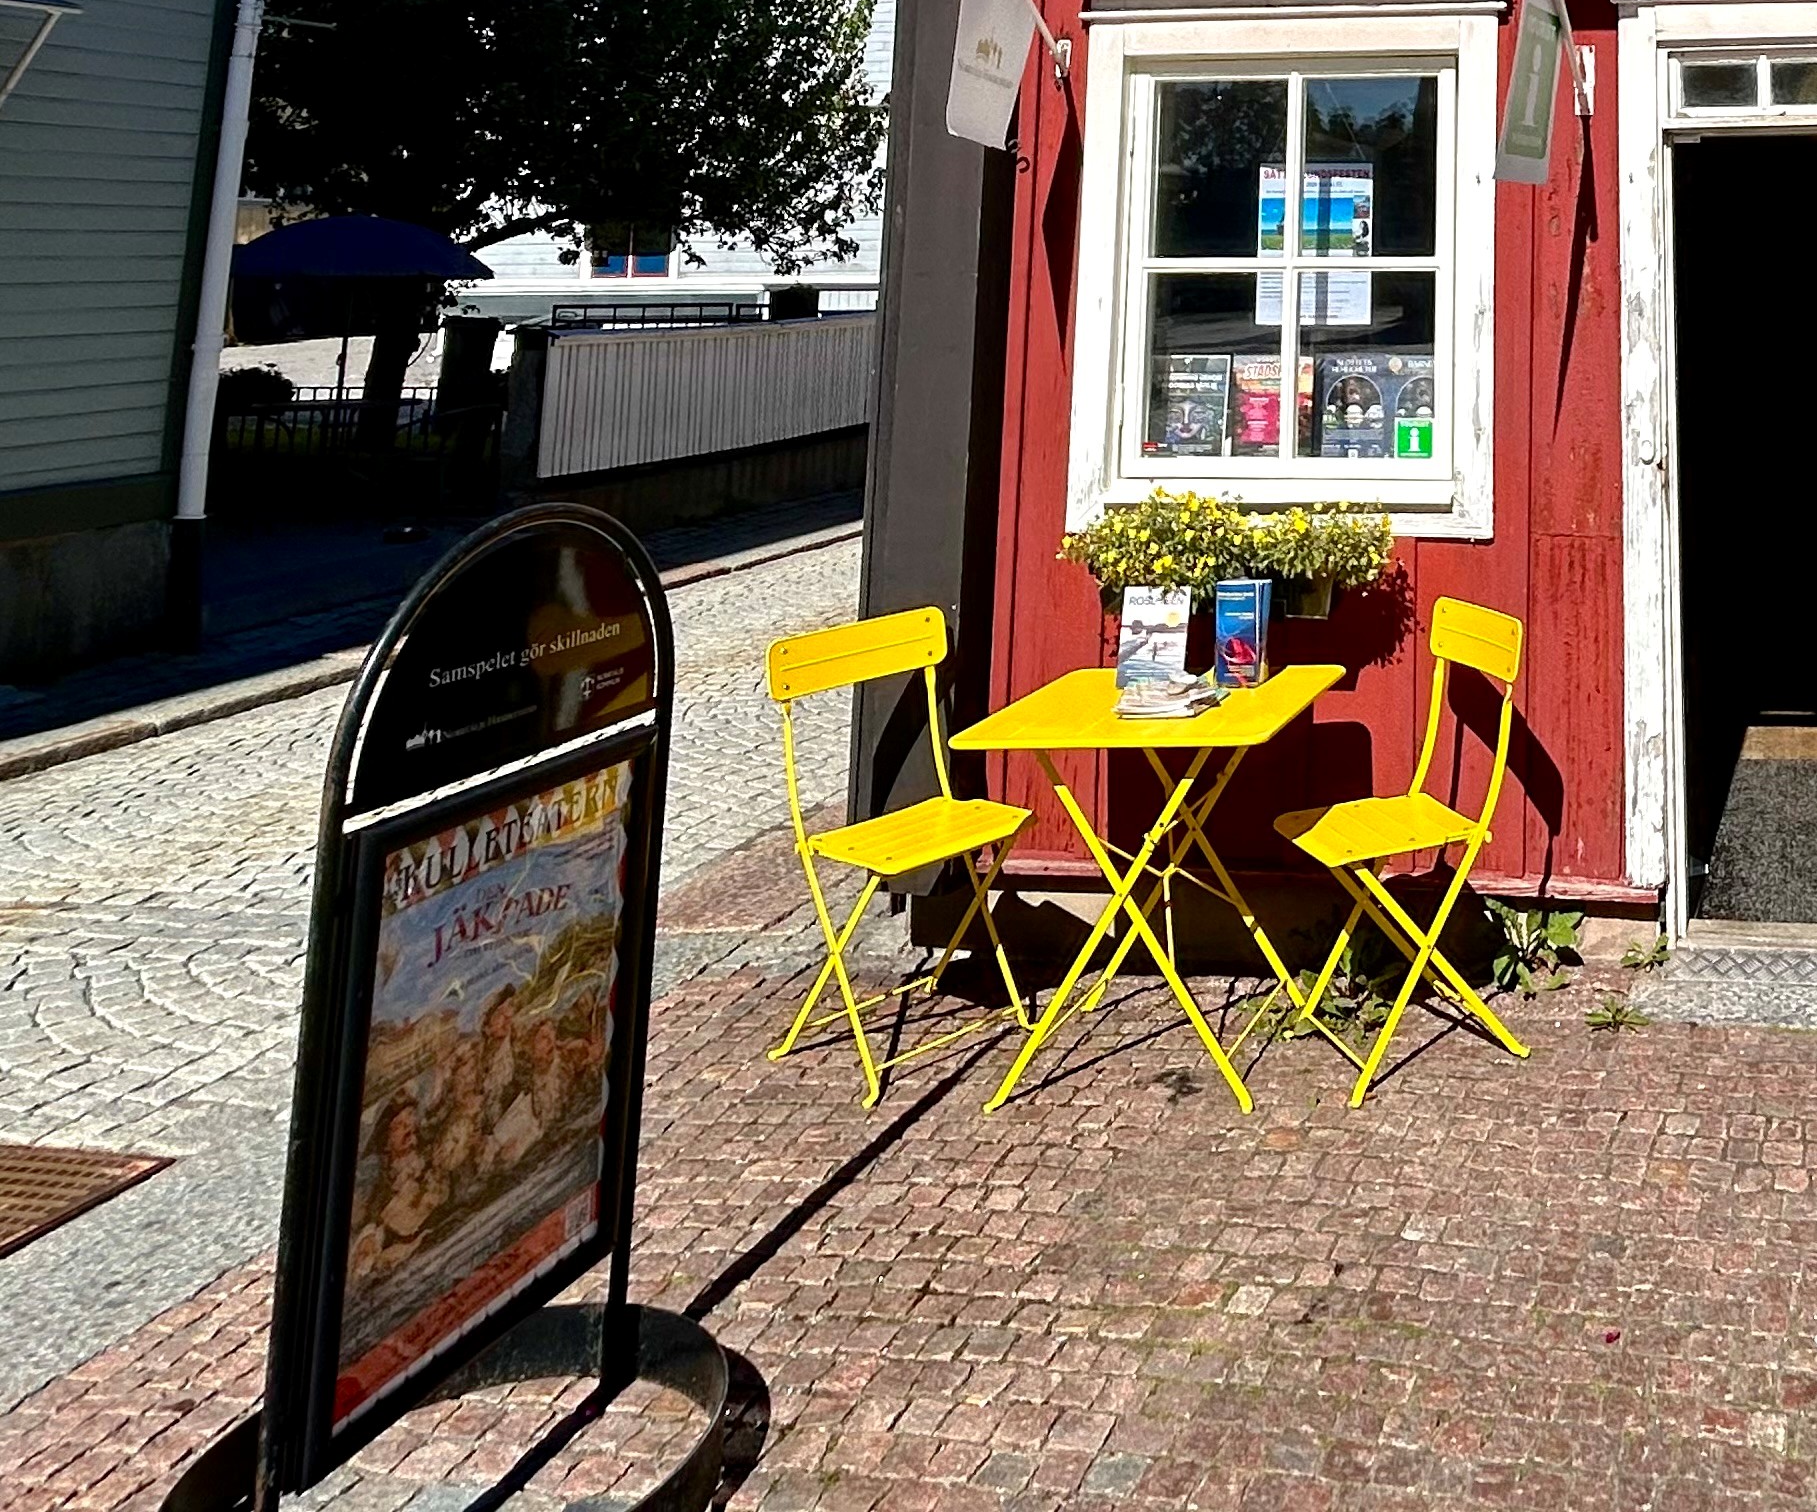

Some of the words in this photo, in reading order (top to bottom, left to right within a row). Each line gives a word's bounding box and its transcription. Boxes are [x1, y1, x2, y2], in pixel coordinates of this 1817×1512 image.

[429, 650, 516, 688] Samspelet
[519, 643, 546, 667] gör
[549, 622, 621, 654] skillnaden
